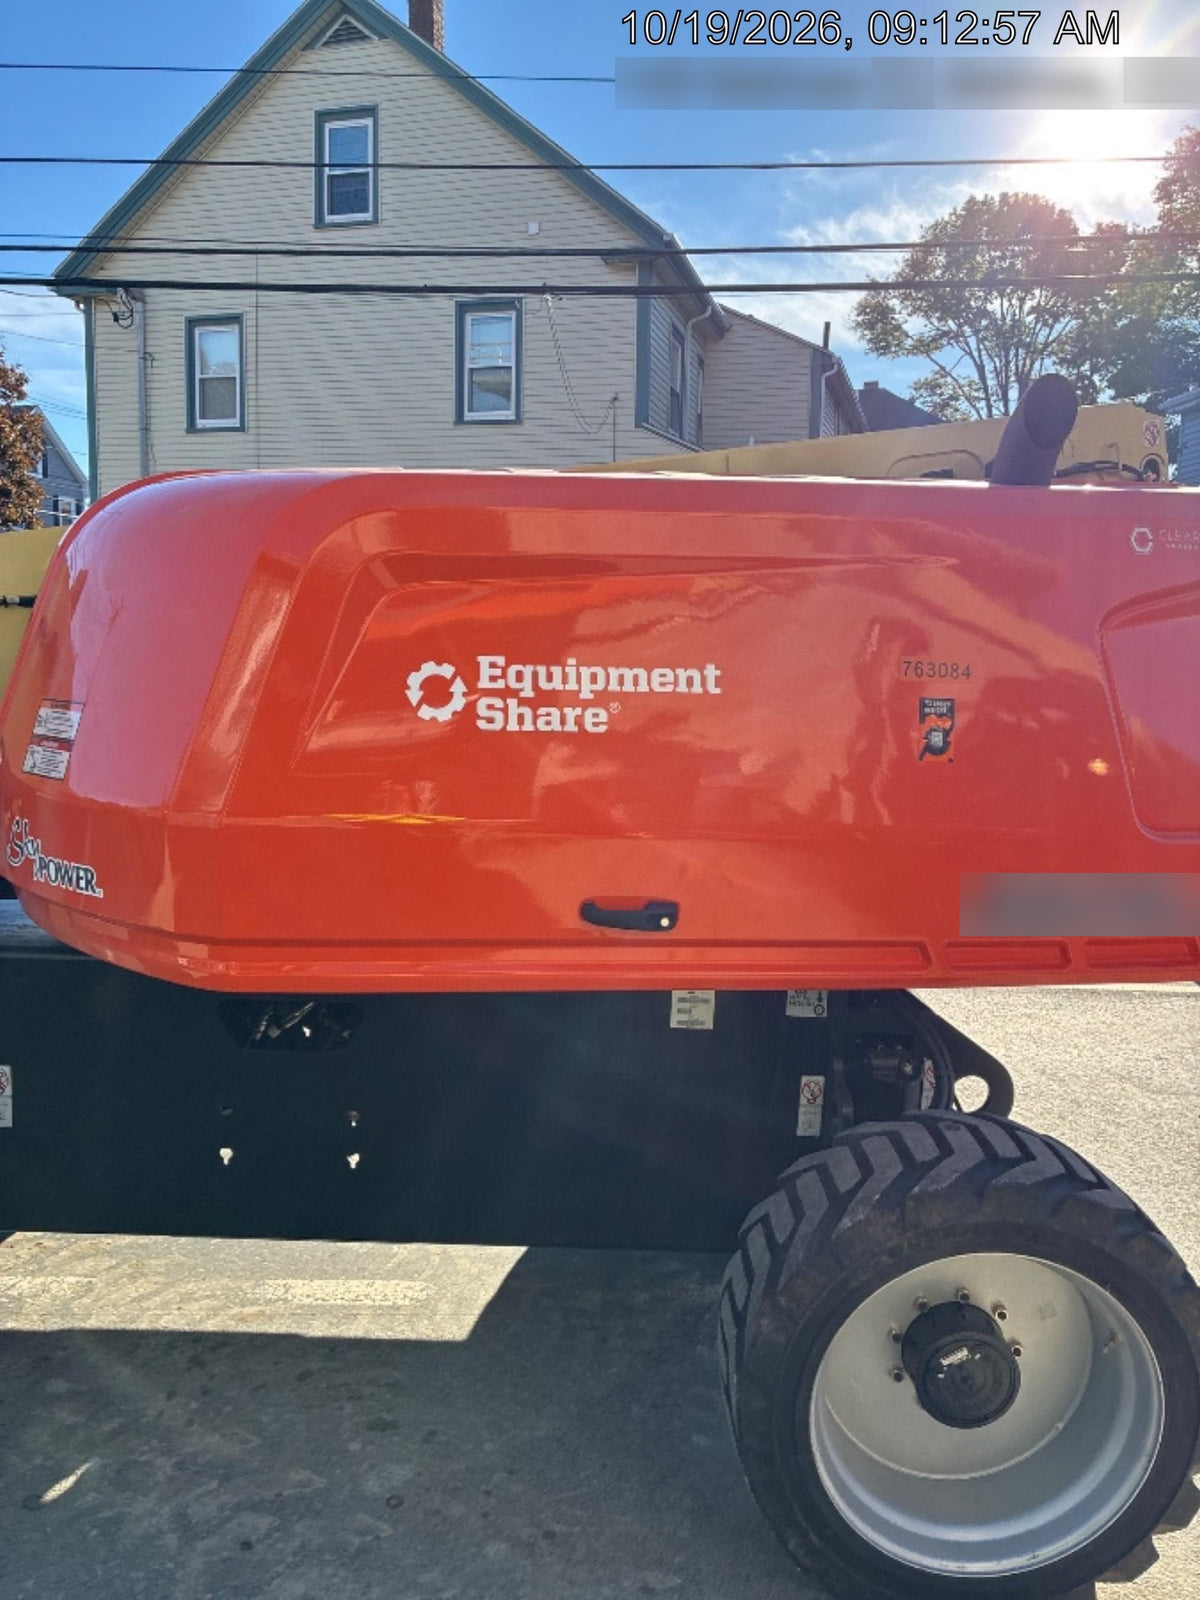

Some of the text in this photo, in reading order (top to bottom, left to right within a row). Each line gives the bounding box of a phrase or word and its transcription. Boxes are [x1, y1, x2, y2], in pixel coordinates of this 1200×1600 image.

[476, 655, 722, 699] Equipment
[902, 660, 972, 680] 763084
[476, 697, 609, 733] Share
[36, 855, 98, 896] POWER
